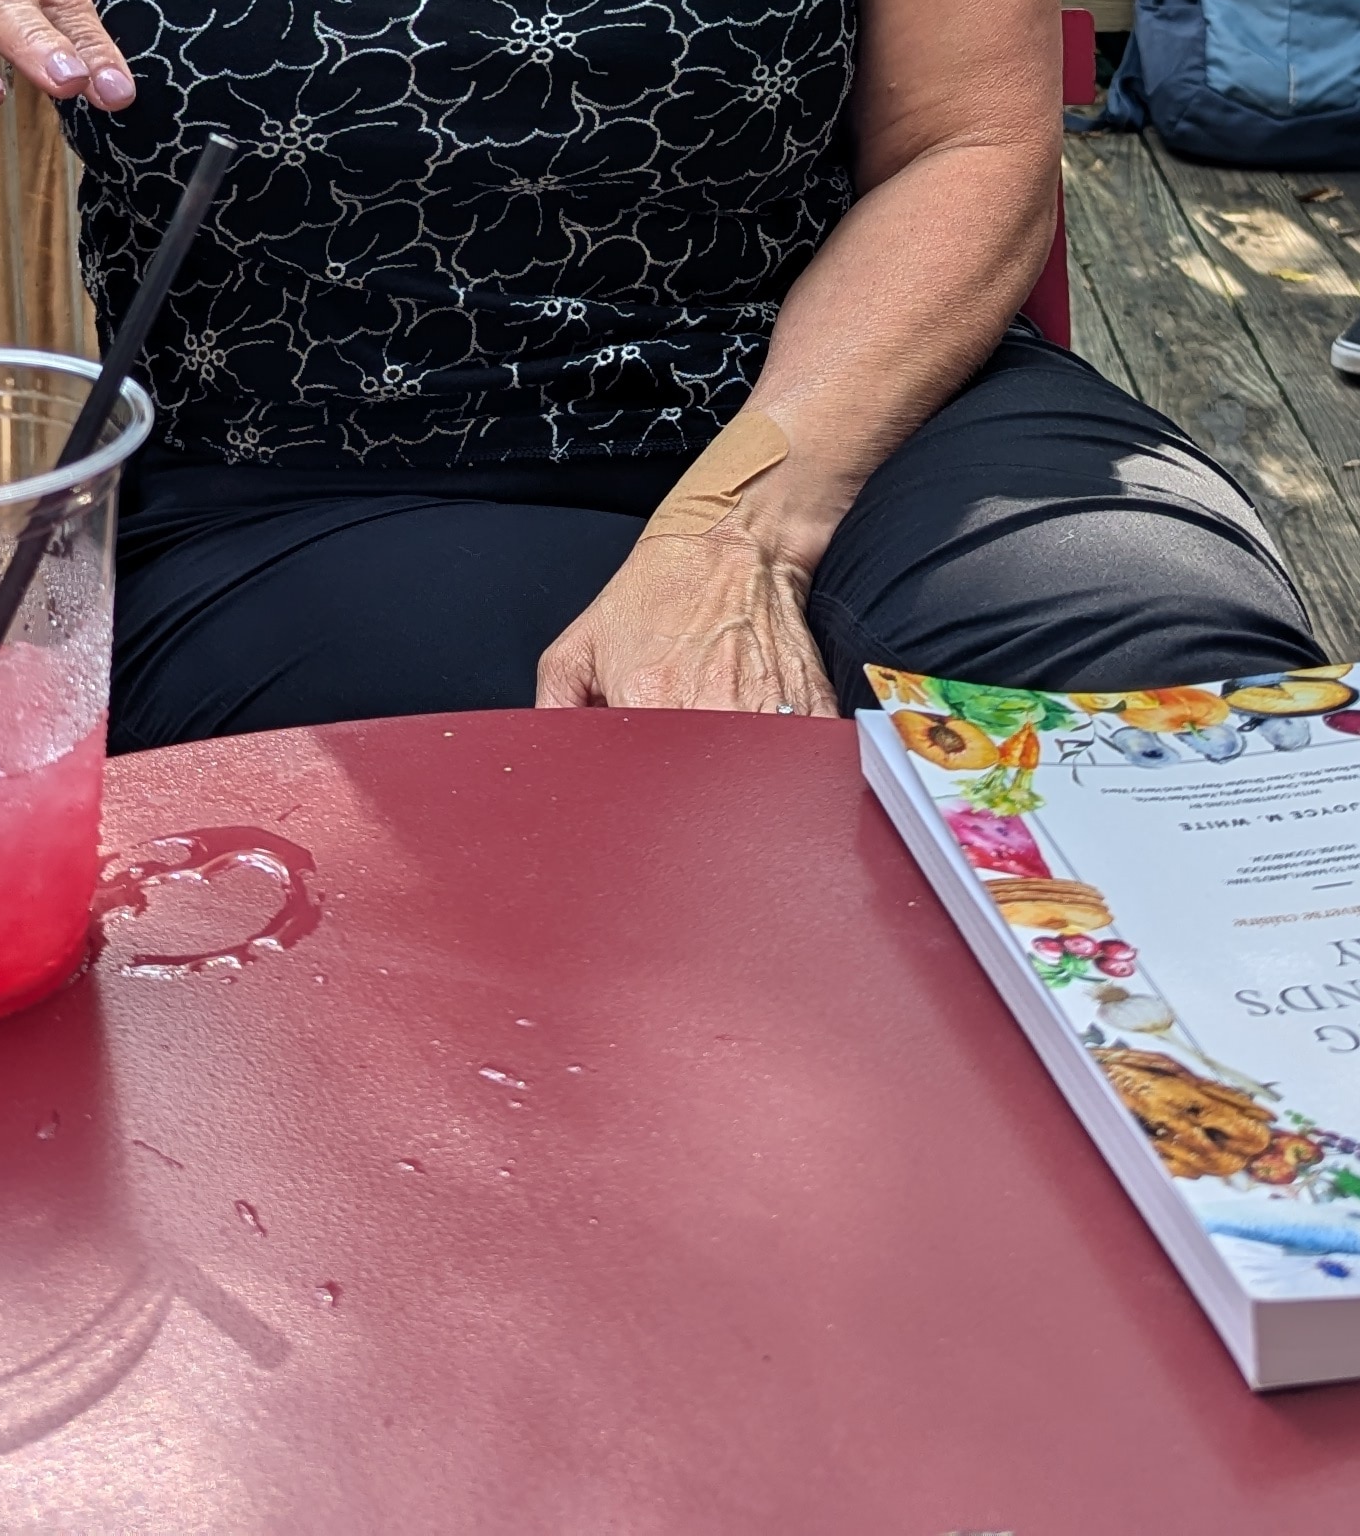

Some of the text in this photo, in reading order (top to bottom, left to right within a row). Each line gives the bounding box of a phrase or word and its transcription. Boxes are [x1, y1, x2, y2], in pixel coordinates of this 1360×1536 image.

[1178, 801, 1360, 832] JOYCE M. WHITE
[1233, 913, 1298, 928] cuisine
